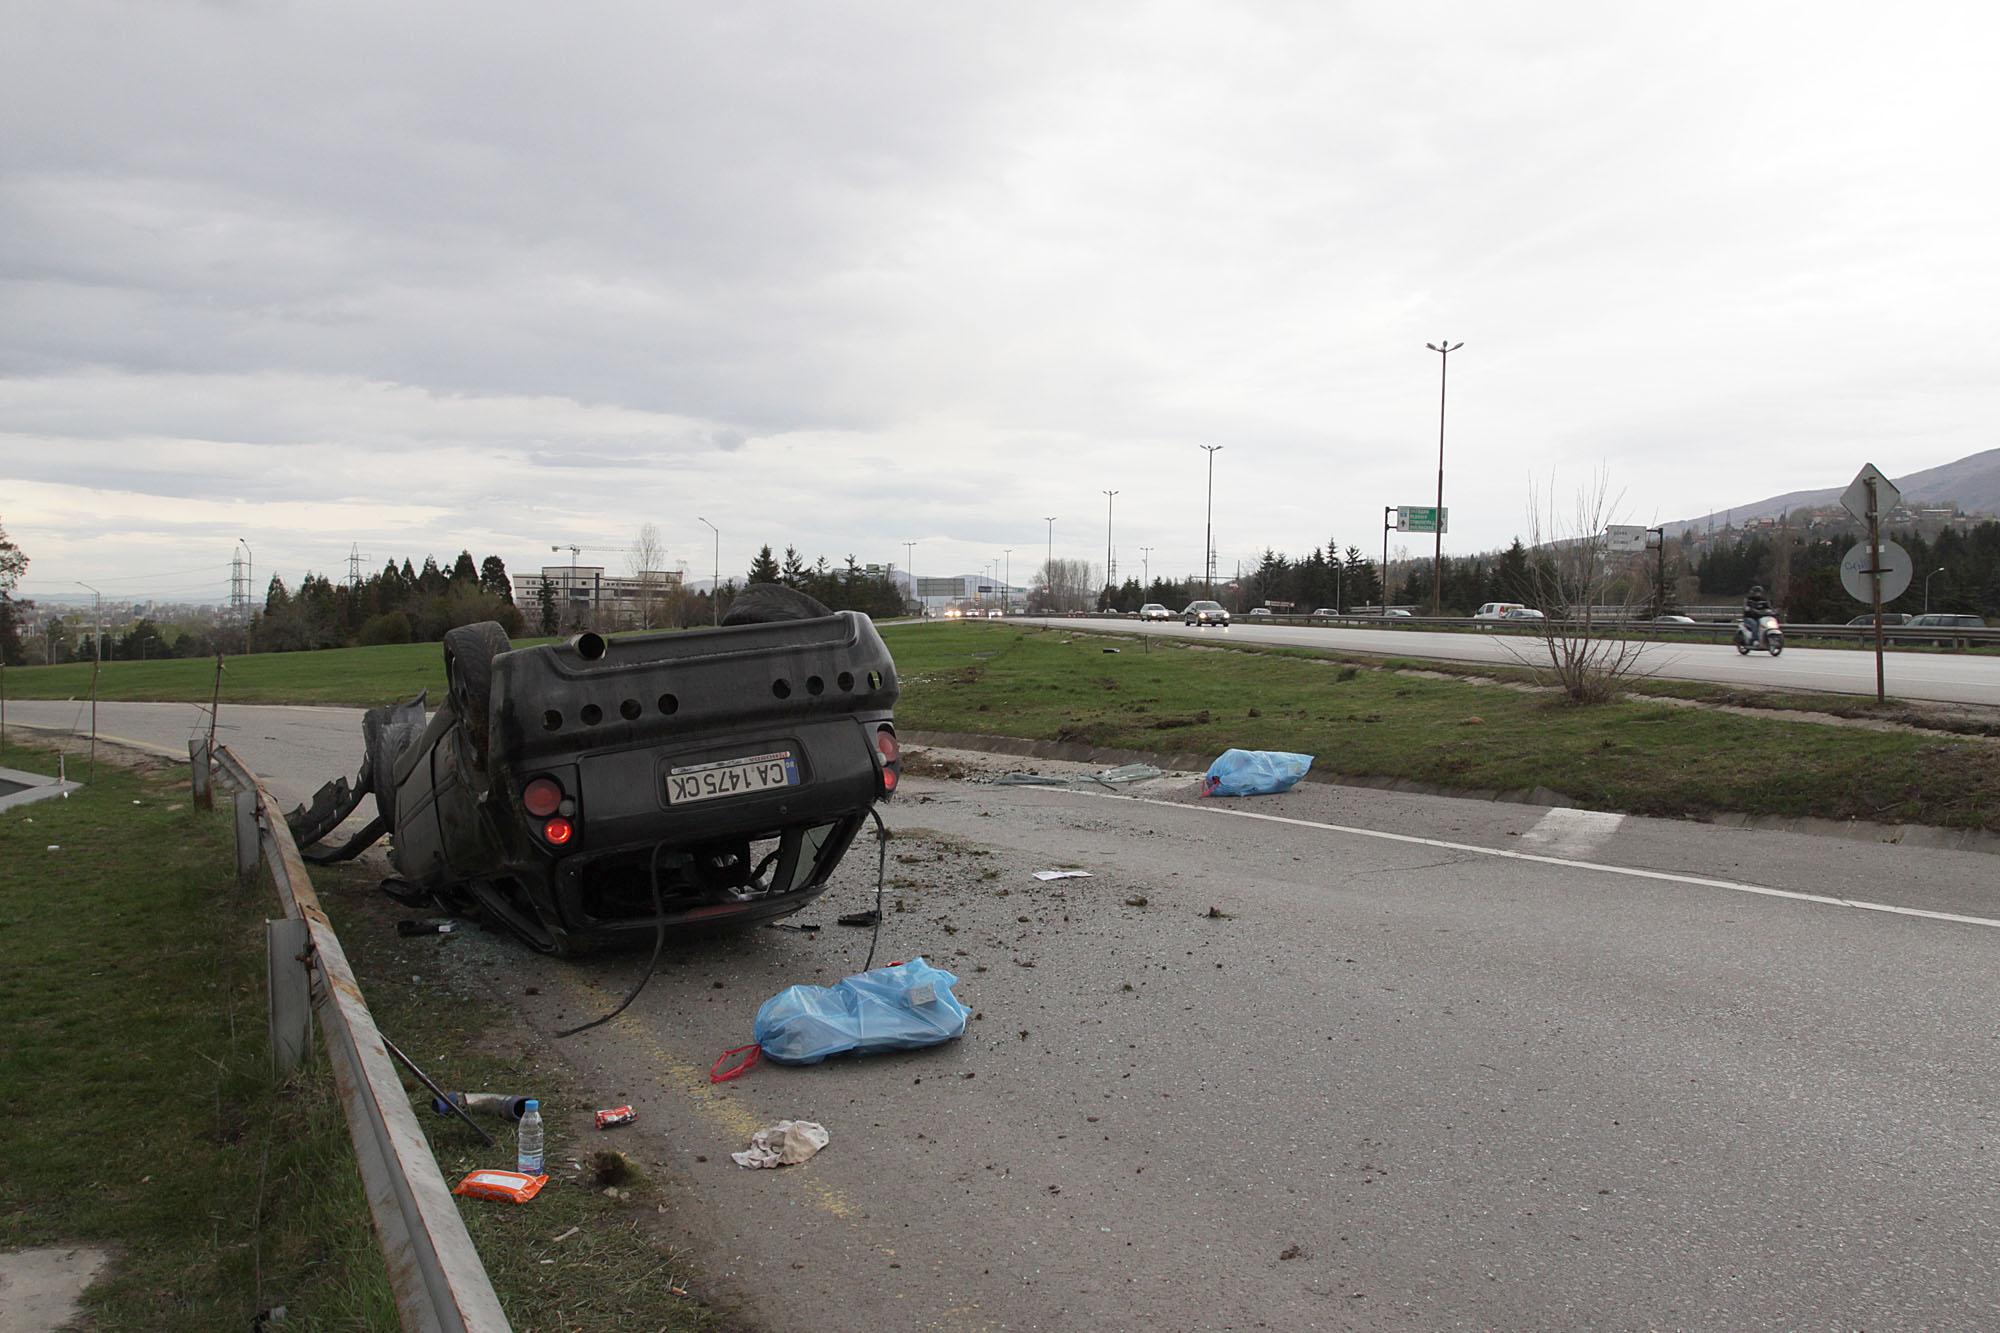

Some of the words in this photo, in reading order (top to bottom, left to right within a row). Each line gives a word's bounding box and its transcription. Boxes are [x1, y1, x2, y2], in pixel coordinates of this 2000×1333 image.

[703, 768, 752, 794] 1475
[757, 763, 784, 786] CA
[672, 777, 700, 800] CK
